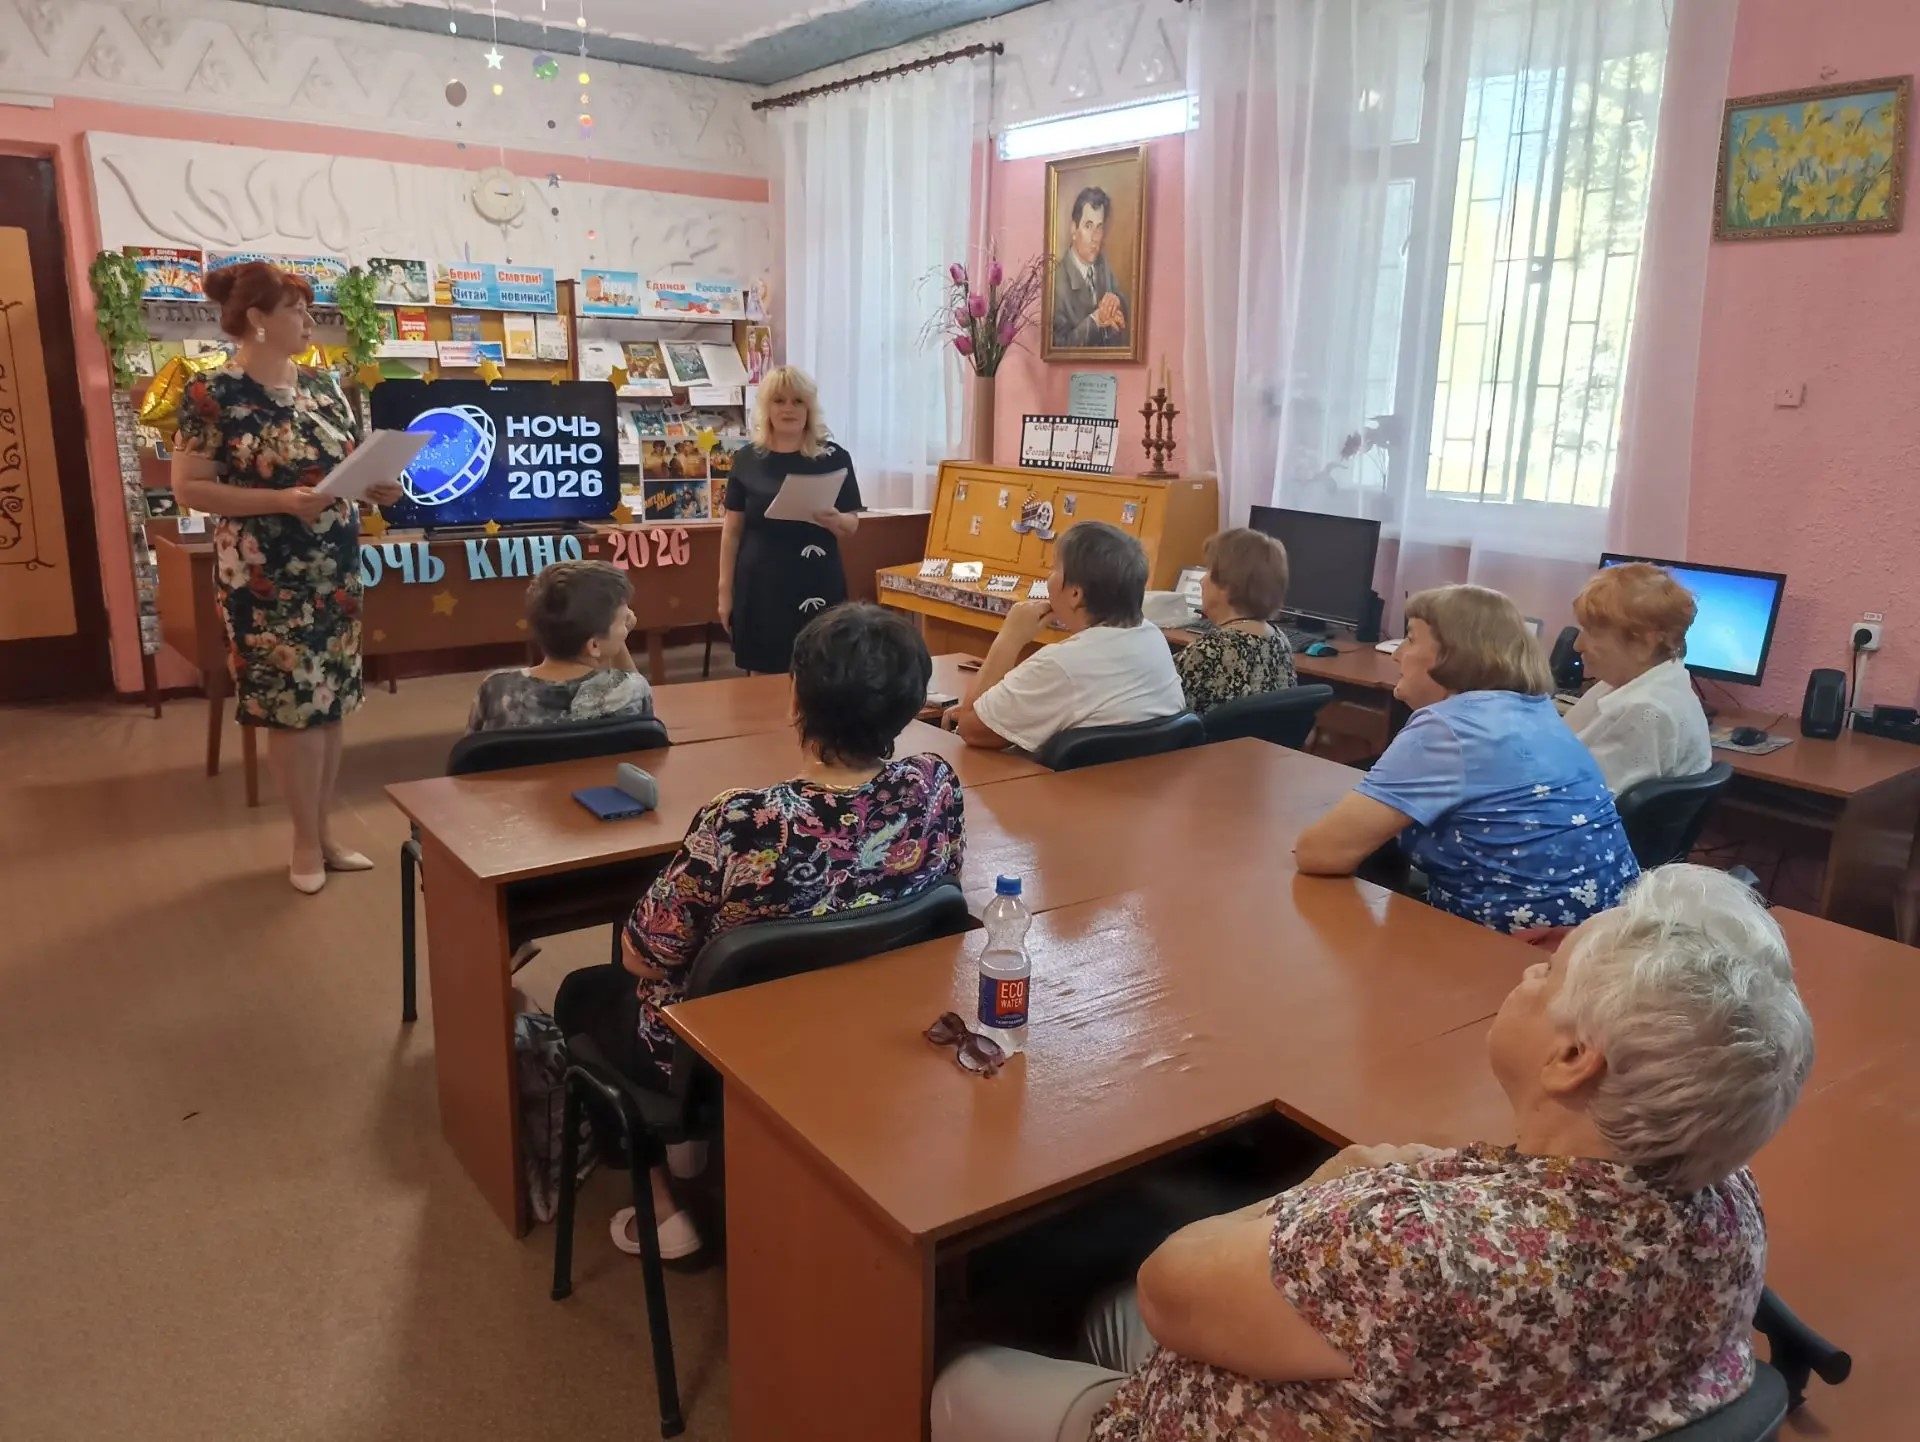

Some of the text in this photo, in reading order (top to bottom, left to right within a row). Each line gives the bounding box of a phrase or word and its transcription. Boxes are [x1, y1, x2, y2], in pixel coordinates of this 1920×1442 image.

[449, 268, 542, 285] Бери! Смотри!
[646, 280, 686, 291] Единая
[453, 287, 550, 304] Читай новинки!
[506, 415, 601, 437] НОЧЬ
[508, 443, 603, 465] КИНО
[508, 469, 603, 500] 2026
[360, 541, 446, 588] ОЧЬ
[1001, 981, 1024, 998] ECO
[1001, 998, 1023, 1009] WATER
